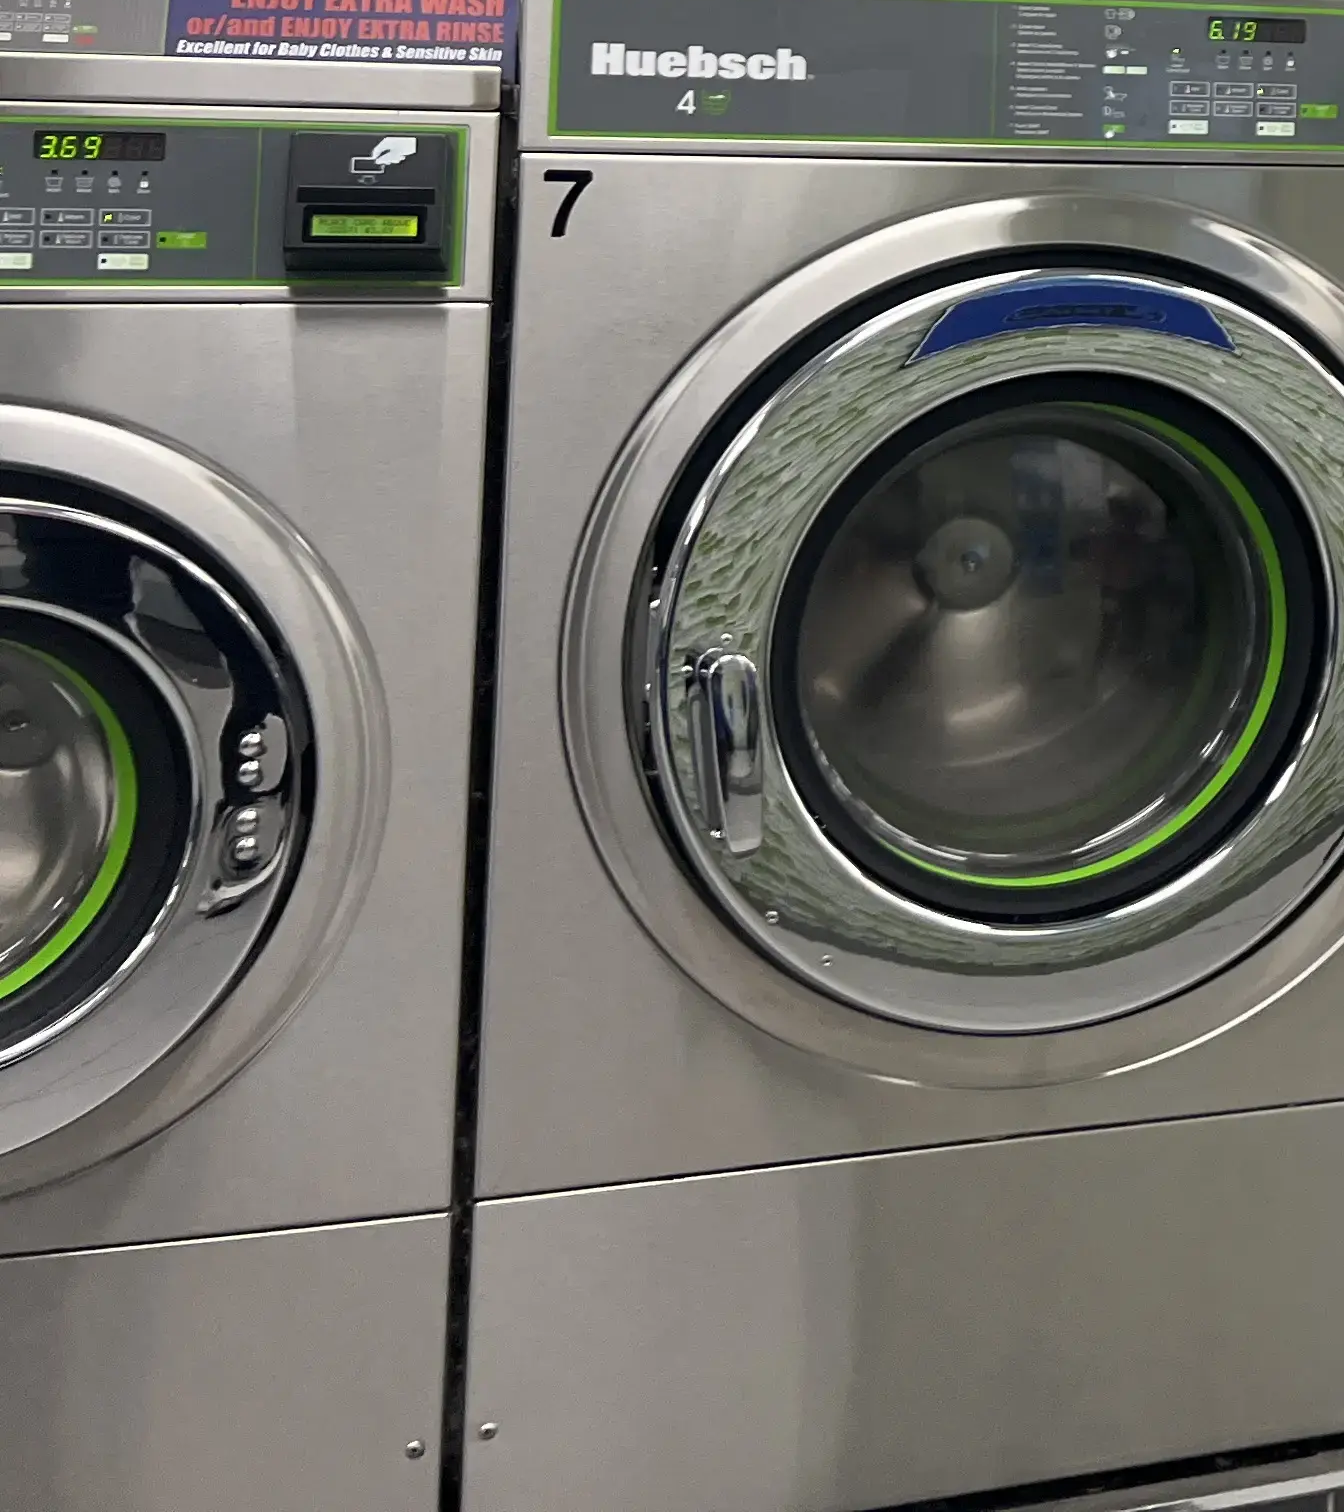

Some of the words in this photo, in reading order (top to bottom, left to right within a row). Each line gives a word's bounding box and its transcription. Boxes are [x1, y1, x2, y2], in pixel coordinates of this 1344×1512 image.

[186, 14, 276, 38] or/and
[281, 17, 353, 39] ENJOY
[358, 19, 430, 41] EXTRA
[436, 21, 505, 43] RINSE
[1208, 20, 1258, 43] 6.19
[176, 39, 251, 56] Excellent
[251, 41, 277, 56] for
[277, 42, 317, 59] Baby
[319, 44, 379, 59] Clothes
[381, 46, 393, 59] &
[395, 45, 467, 61] Sensitive
[468, 46, 503, 62] Skin
[590, 41, 809, 82] Huebsch
[675, 89, 697, 115] 4
[40, 134, 102, 160] 3.69
[543, 169, 594, 238] 7
